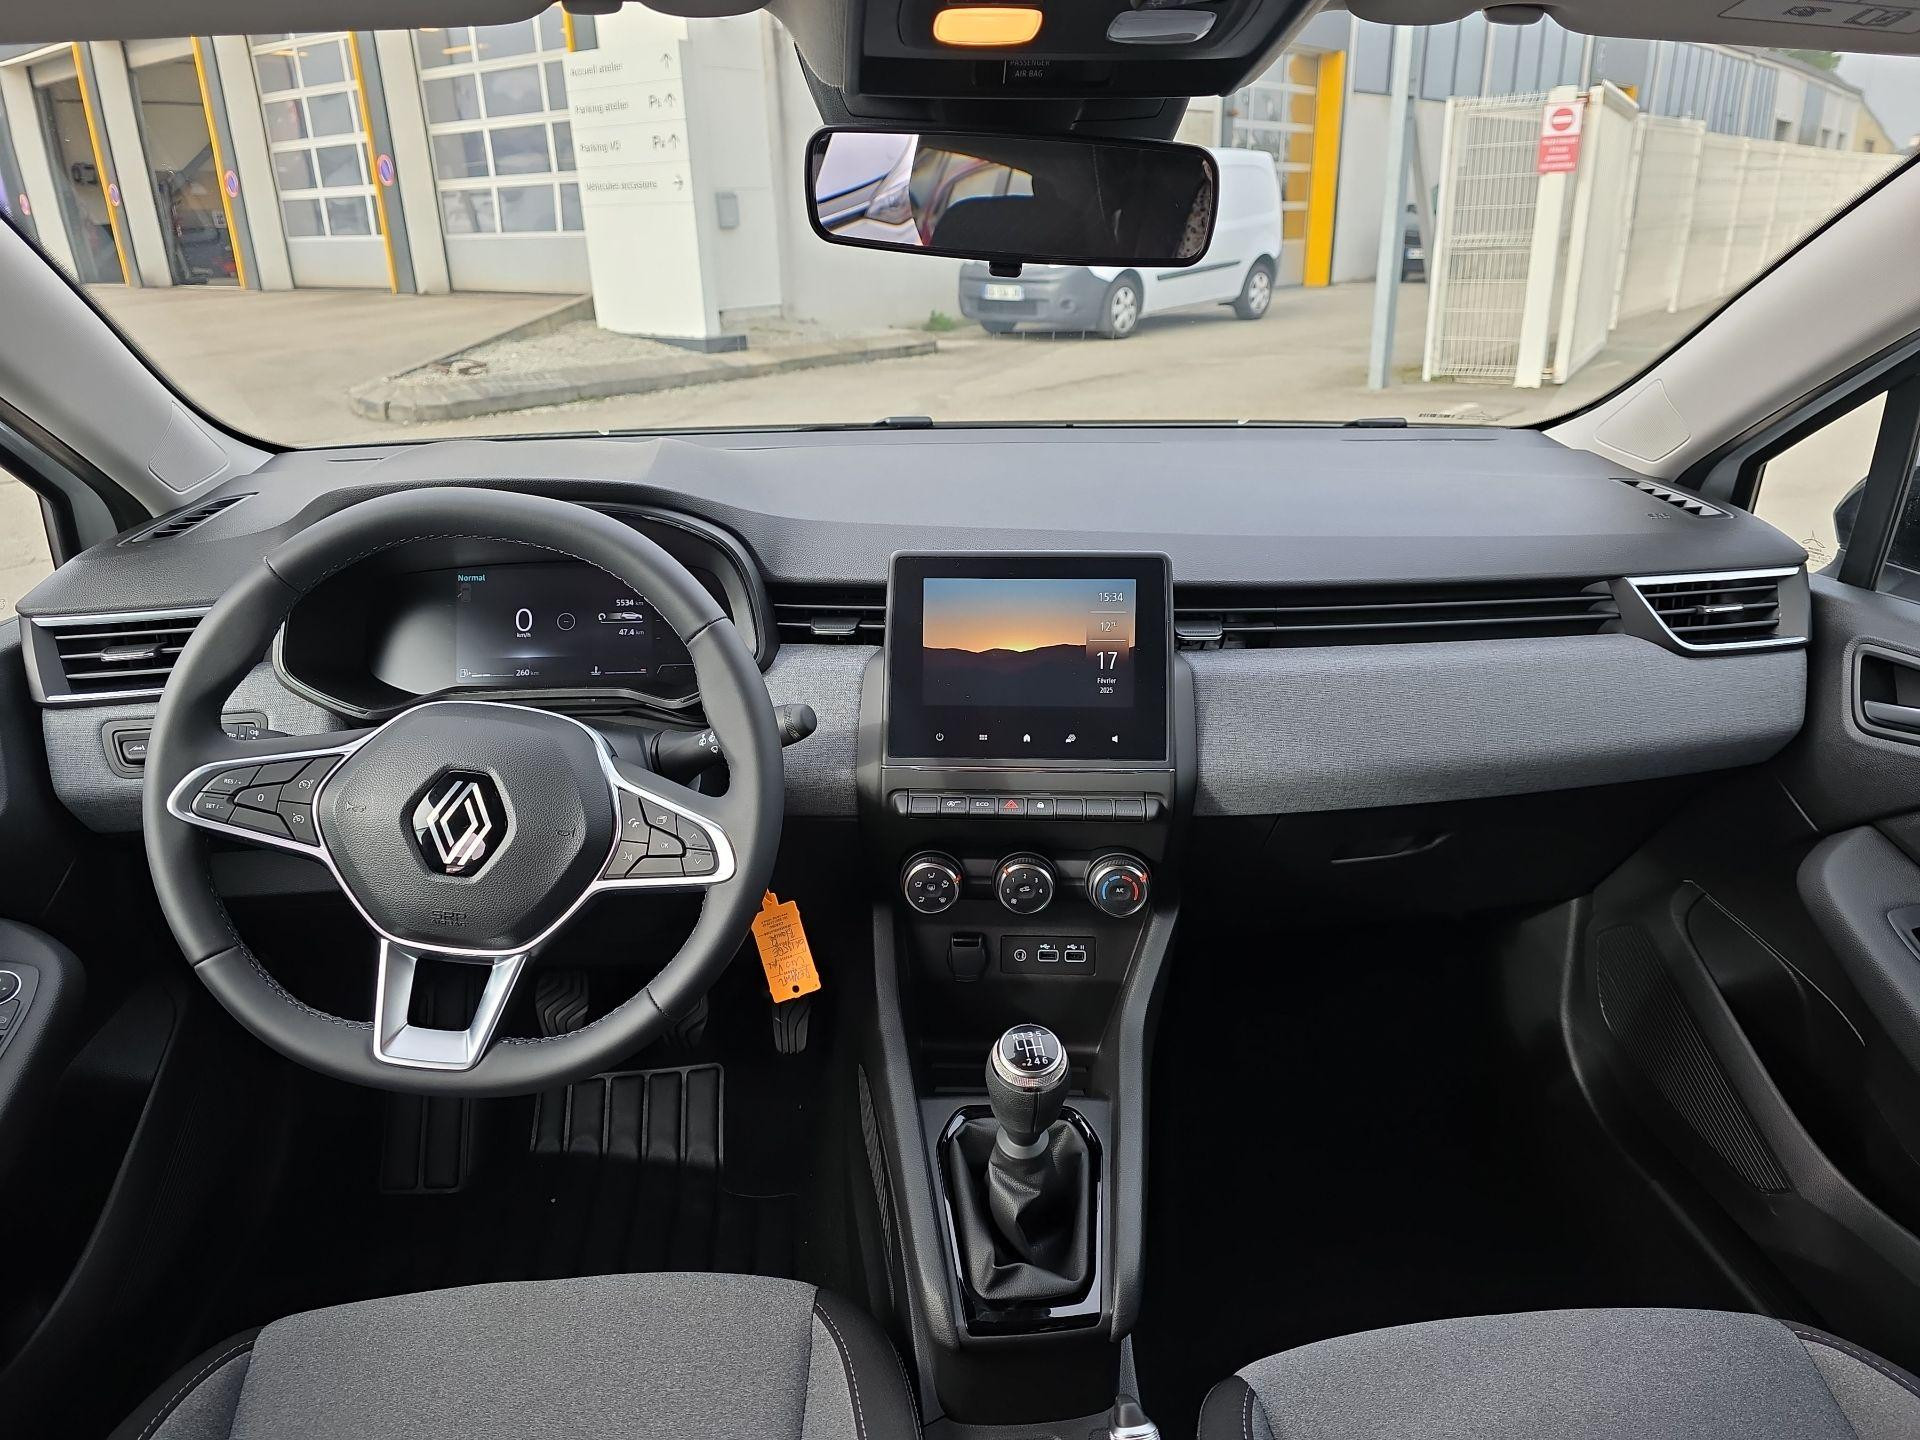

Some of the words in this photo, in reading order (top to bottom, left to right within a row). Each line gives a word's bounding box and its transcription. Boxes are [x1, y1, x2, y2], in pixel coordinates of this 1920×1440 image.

[1010, 57, 1051, 66] PASSENGER
[1028, 70, 1043, 78] BAG
[457, 574, 486, 582] Normal
[1098, 592, 1123, 602] 15:34
[616, 599, 634, 607] 5534
[515, 608, 533, 632] 0
[618, 628, 635, 636] 47.4
[1096, 651, 1118, 670] 17
[515, 668, 530, 677] 260
[1026, 1058, 1033, 1067] 2
[1034, 1057, 1040, 1065] 4
[1042, 1056, 1048, 1065] 6
